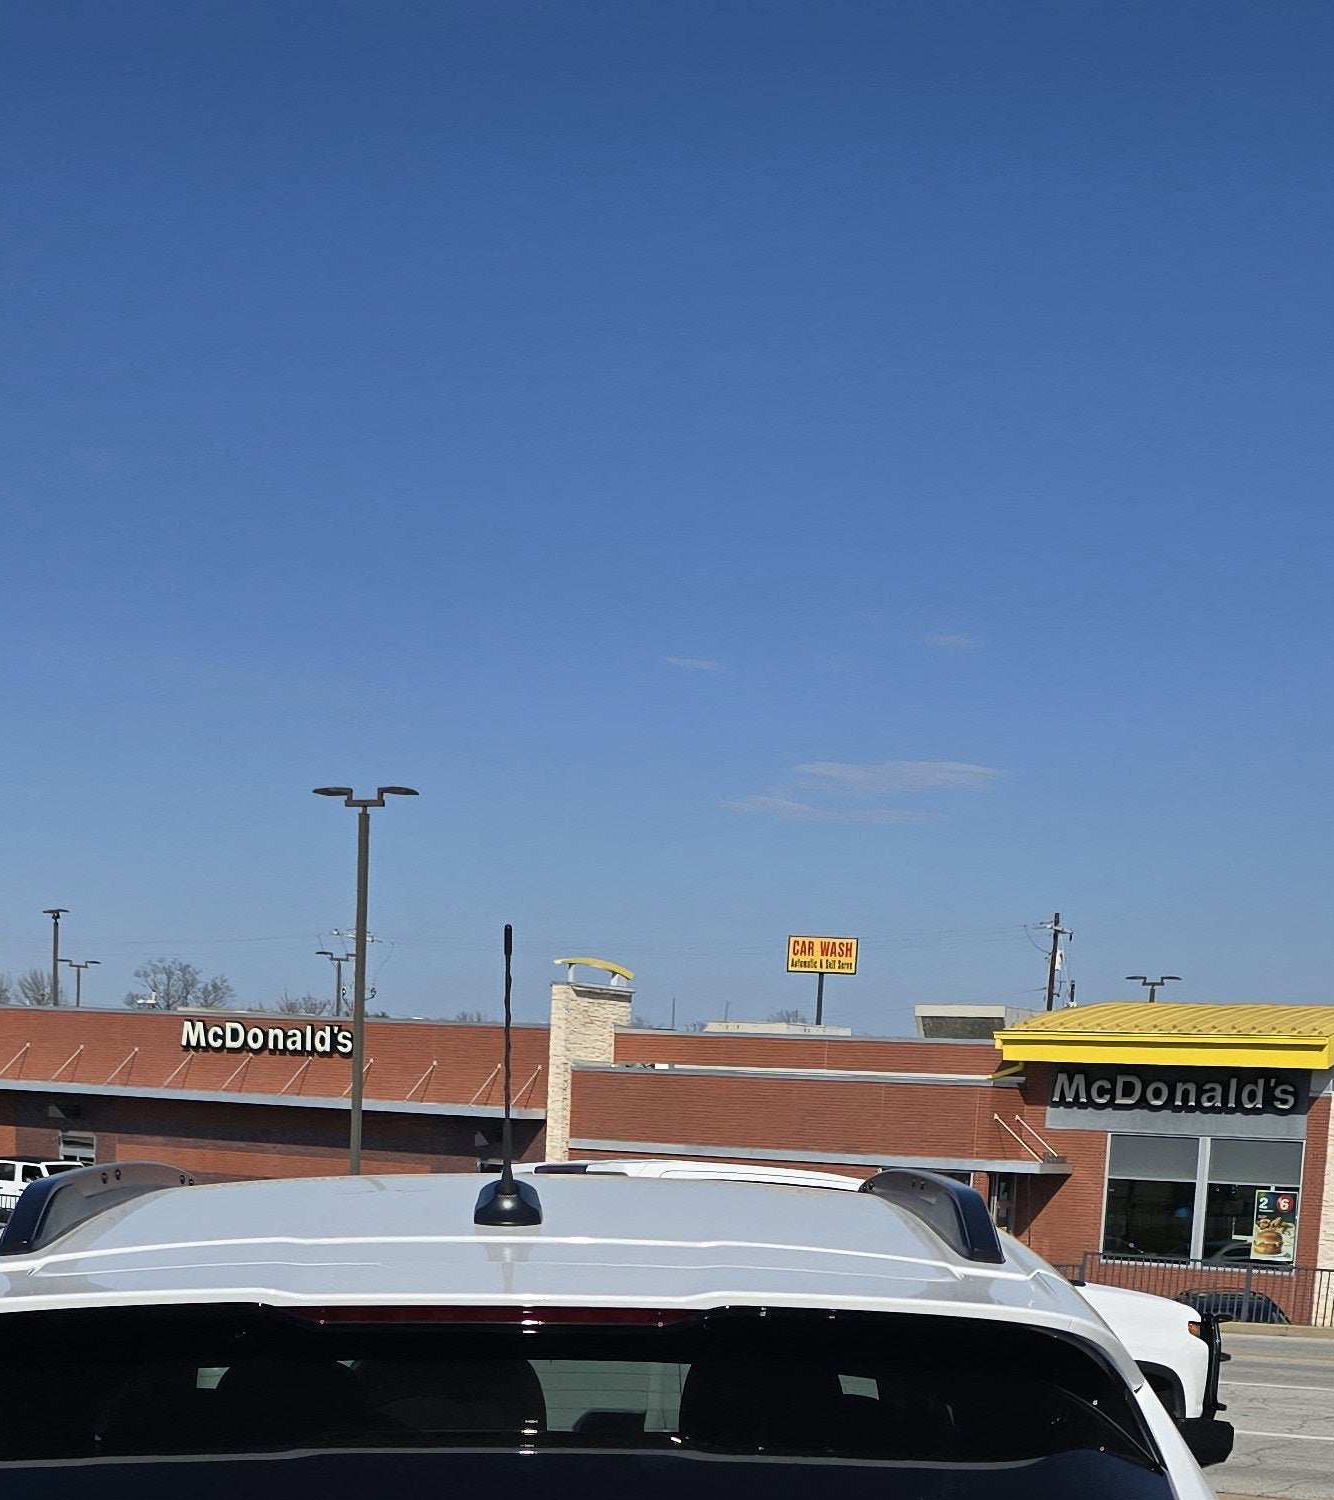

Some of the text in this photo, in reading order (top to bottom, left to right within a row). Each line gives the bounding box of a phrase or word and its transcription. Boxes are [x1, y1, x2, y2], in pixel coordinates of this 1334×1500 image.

[792, 940, 853, 958] CAR WASH
[181, 1020, 354, 1055] McDonald's
[1051, 1072, 1296, 1110] McDonald's
